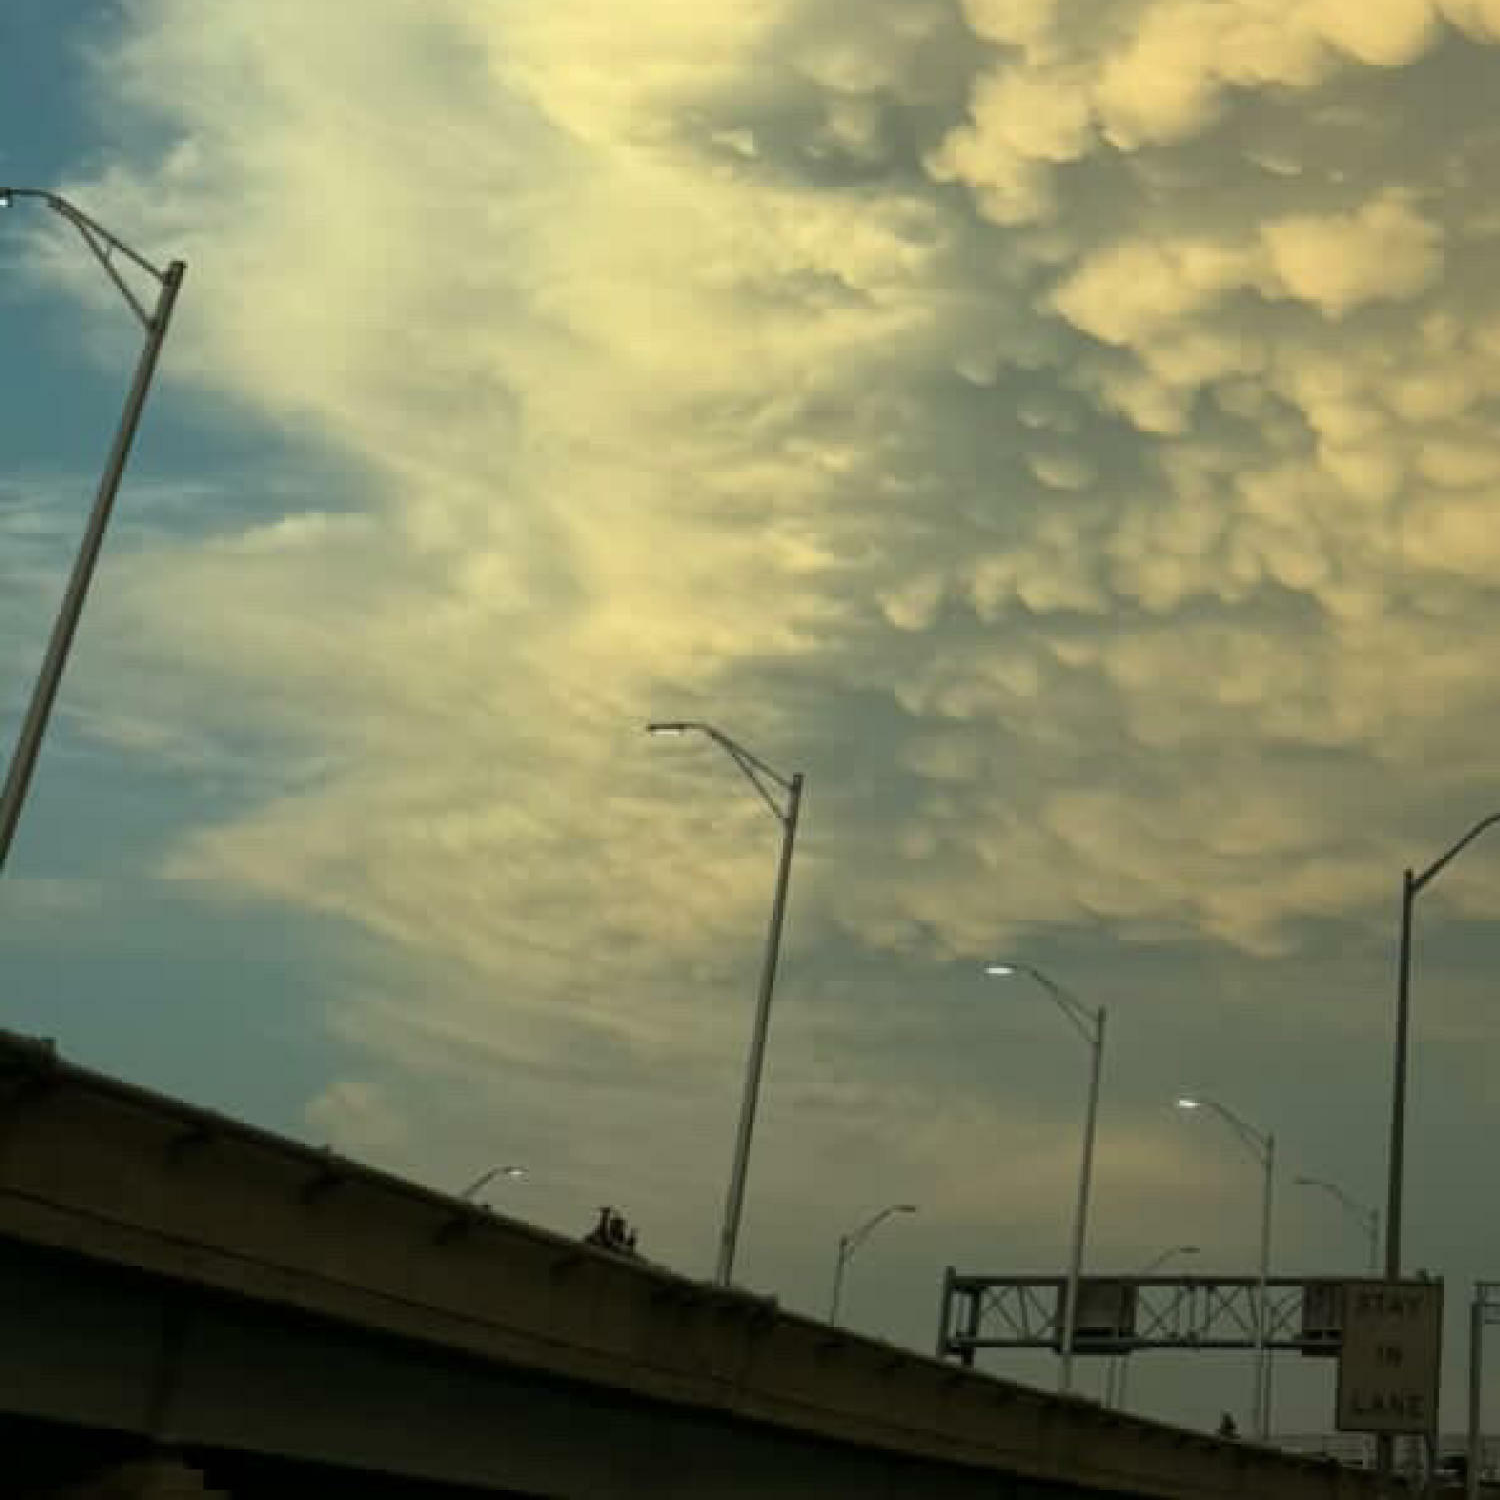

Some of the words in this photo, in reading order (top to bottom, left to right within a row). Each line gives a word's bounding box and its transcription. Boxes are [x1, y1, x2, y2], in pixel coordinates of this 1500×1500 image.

[1356, 1293, 1421, 1318] STAY
[1376, 1345, 1404, 1369] IN
[1351, 1393, 1425, 1420] LANE
